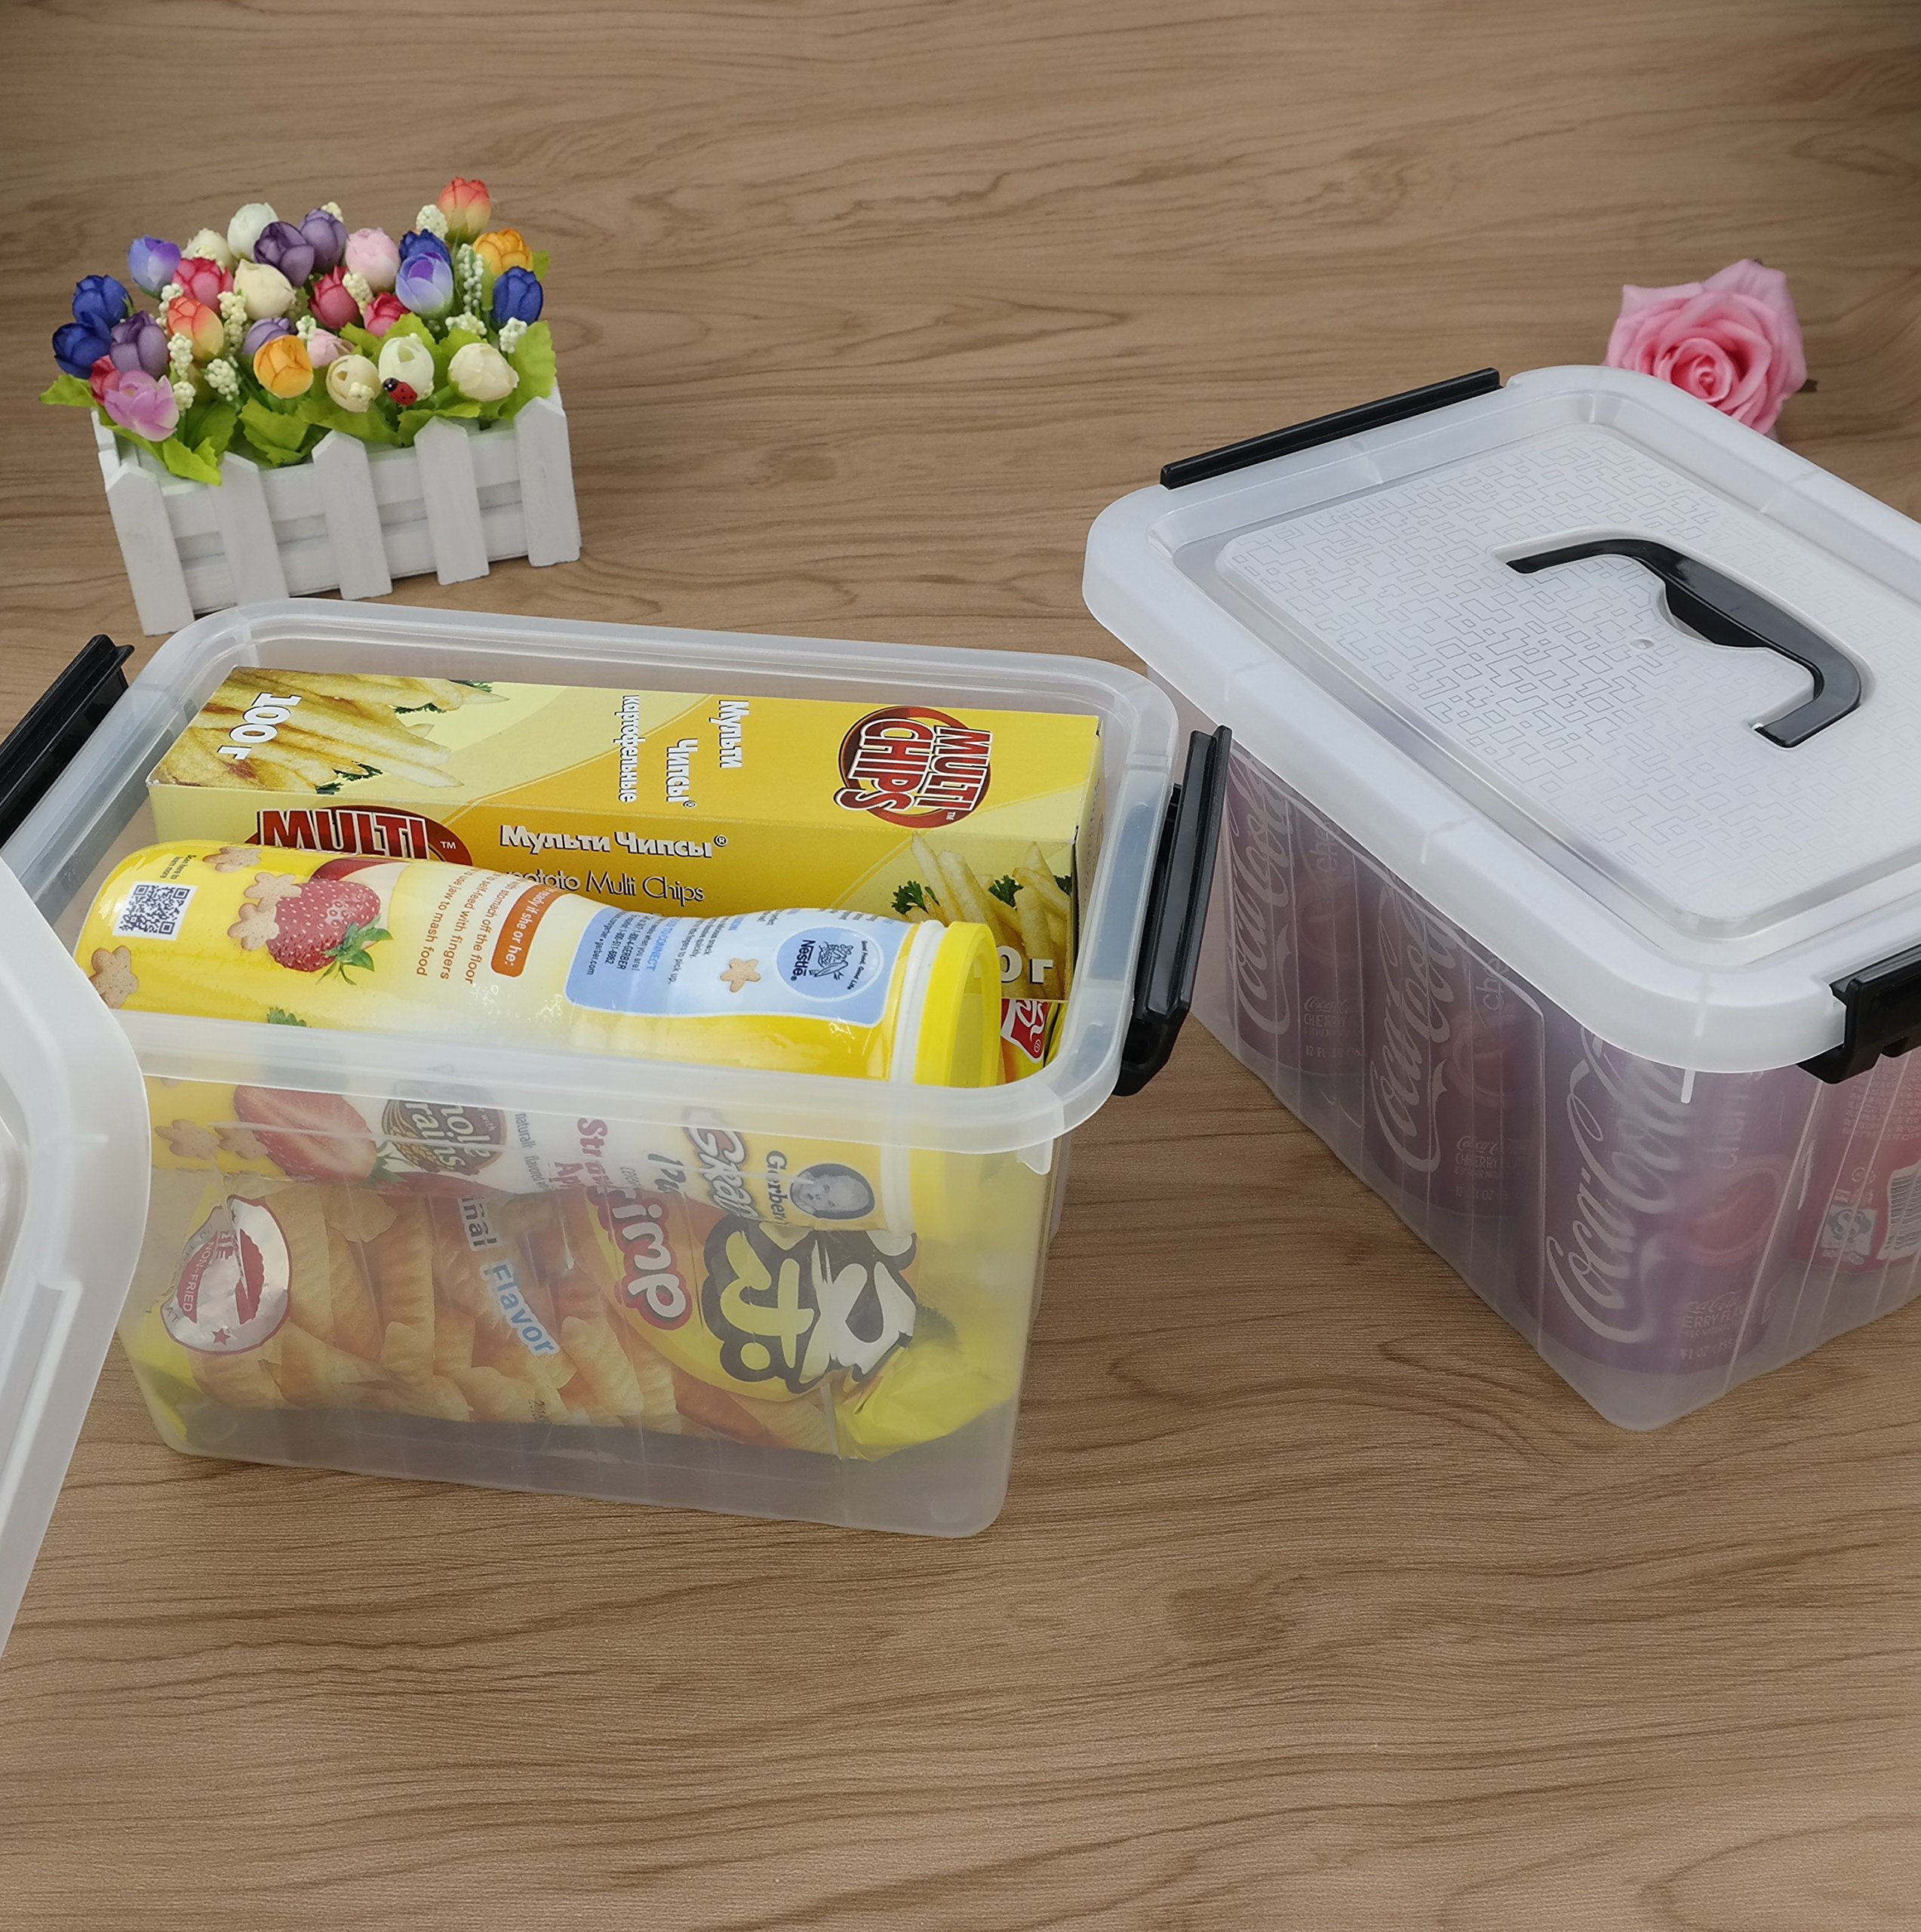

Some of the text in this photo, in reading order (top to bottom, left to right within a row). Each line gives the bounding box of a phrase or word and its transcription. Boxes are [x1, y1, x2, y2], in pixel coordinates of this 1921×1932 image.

[613, 694, 646, 803] картофельные
[708, 700, 749, 769] Мульти
[833, 718, 937, 812] CHIPS
[914, 724, 994, 812] MULTI
[256, 808, 431, 860] MULTI
[499, 824, 610, 854] Мульти
[444, 884, 460, 903] jaw
[465, 880, 490, 910] self-feed
[489, 888, 510, 918] stomach
[586, 869, 637, 897] Multi
[641, 875, 706, 907] Chips
[438, 901, 451, 911] to
[454, 908, 471, 932] with
[426, 912, 444, 943] mash
[482, 919, 492, 934] off
[516, 913, 534, 930] she
[472, 930, 487, 952] the
[512, 933, 524, 943] or
[647, 934, 669, 971] CONNECT
[416, 946, 435, 977] food
[441, 934, 463, 980] fingers
[465, 954, 483, 984] floor
[504, 946, 523, 967] he:
[183, 1242, 215, 1312] NON-FRIED
[484, 1264, 555, 1352] Flavor
